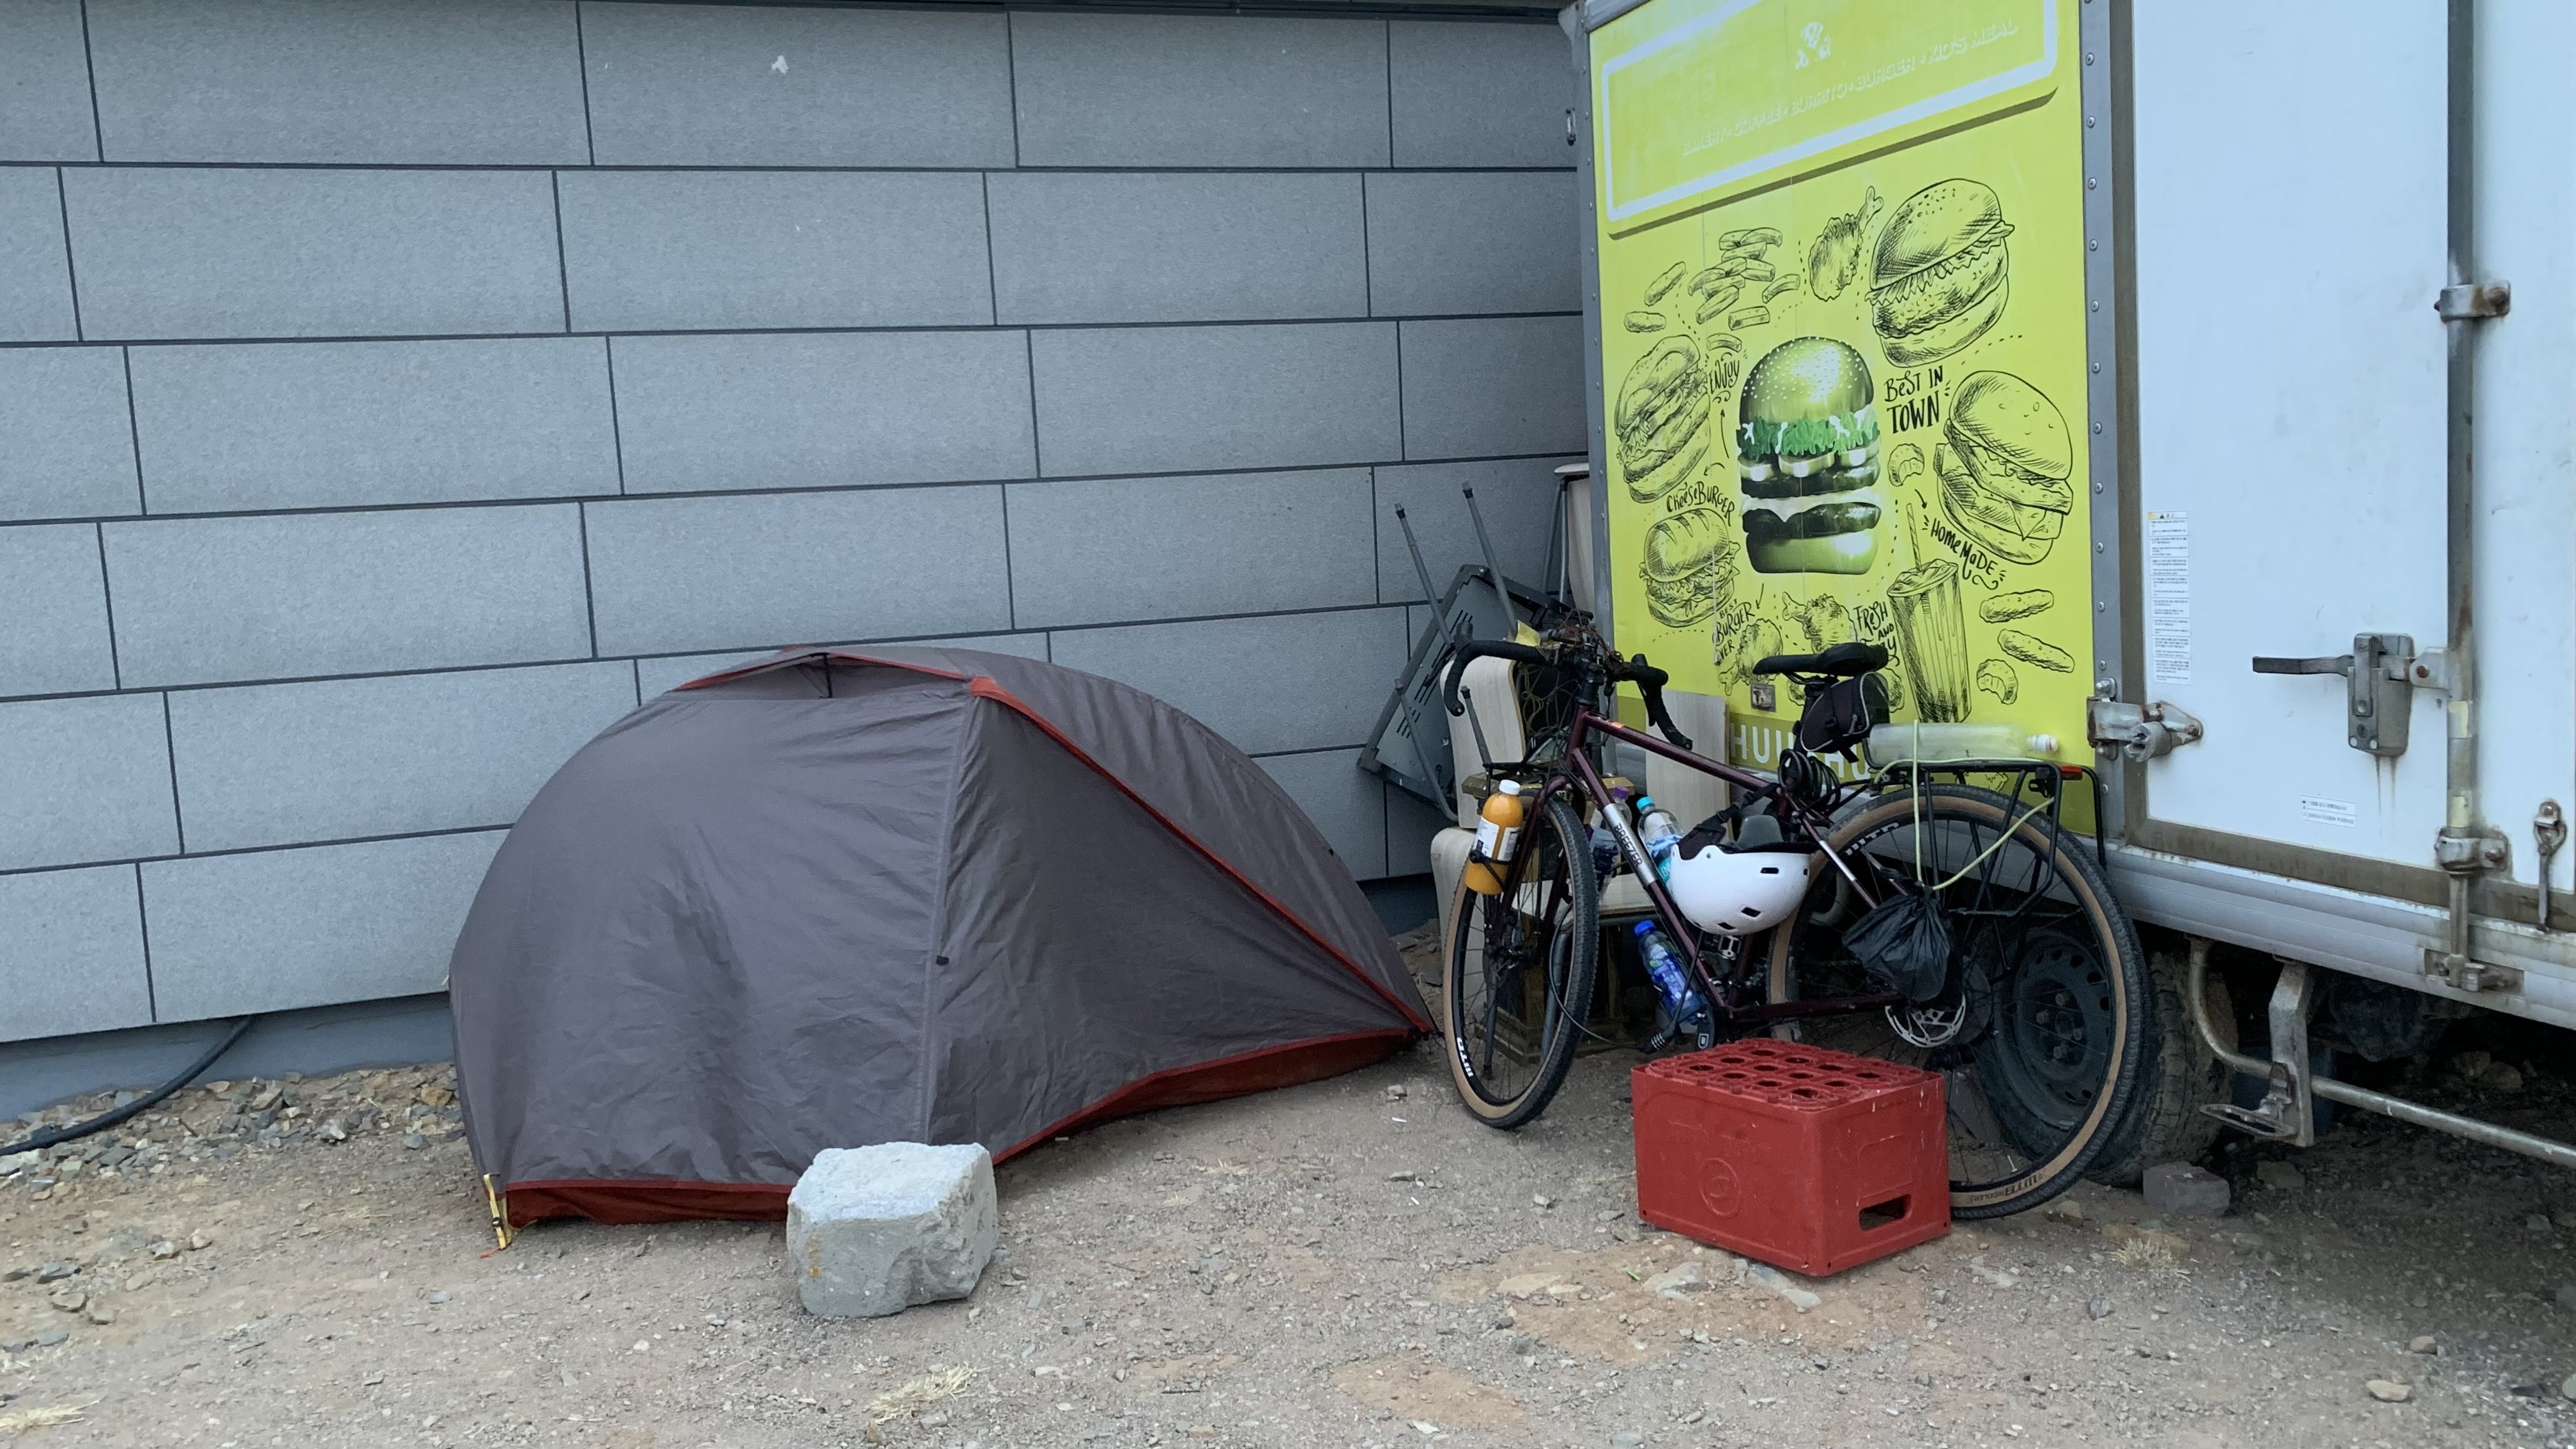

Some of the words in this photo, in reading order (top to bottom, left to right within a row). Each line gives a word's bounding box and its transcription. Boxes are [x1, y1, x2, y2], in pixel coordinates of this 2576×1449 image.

[1928, 365, 1943, 388] IN
[1887, 390, 1939, 434] TOWN
[1719, 599, 1737, 619] BEST
[1878, 623, 1894, 641] AND
[1613, 822, 1643, 868] BREEZER
